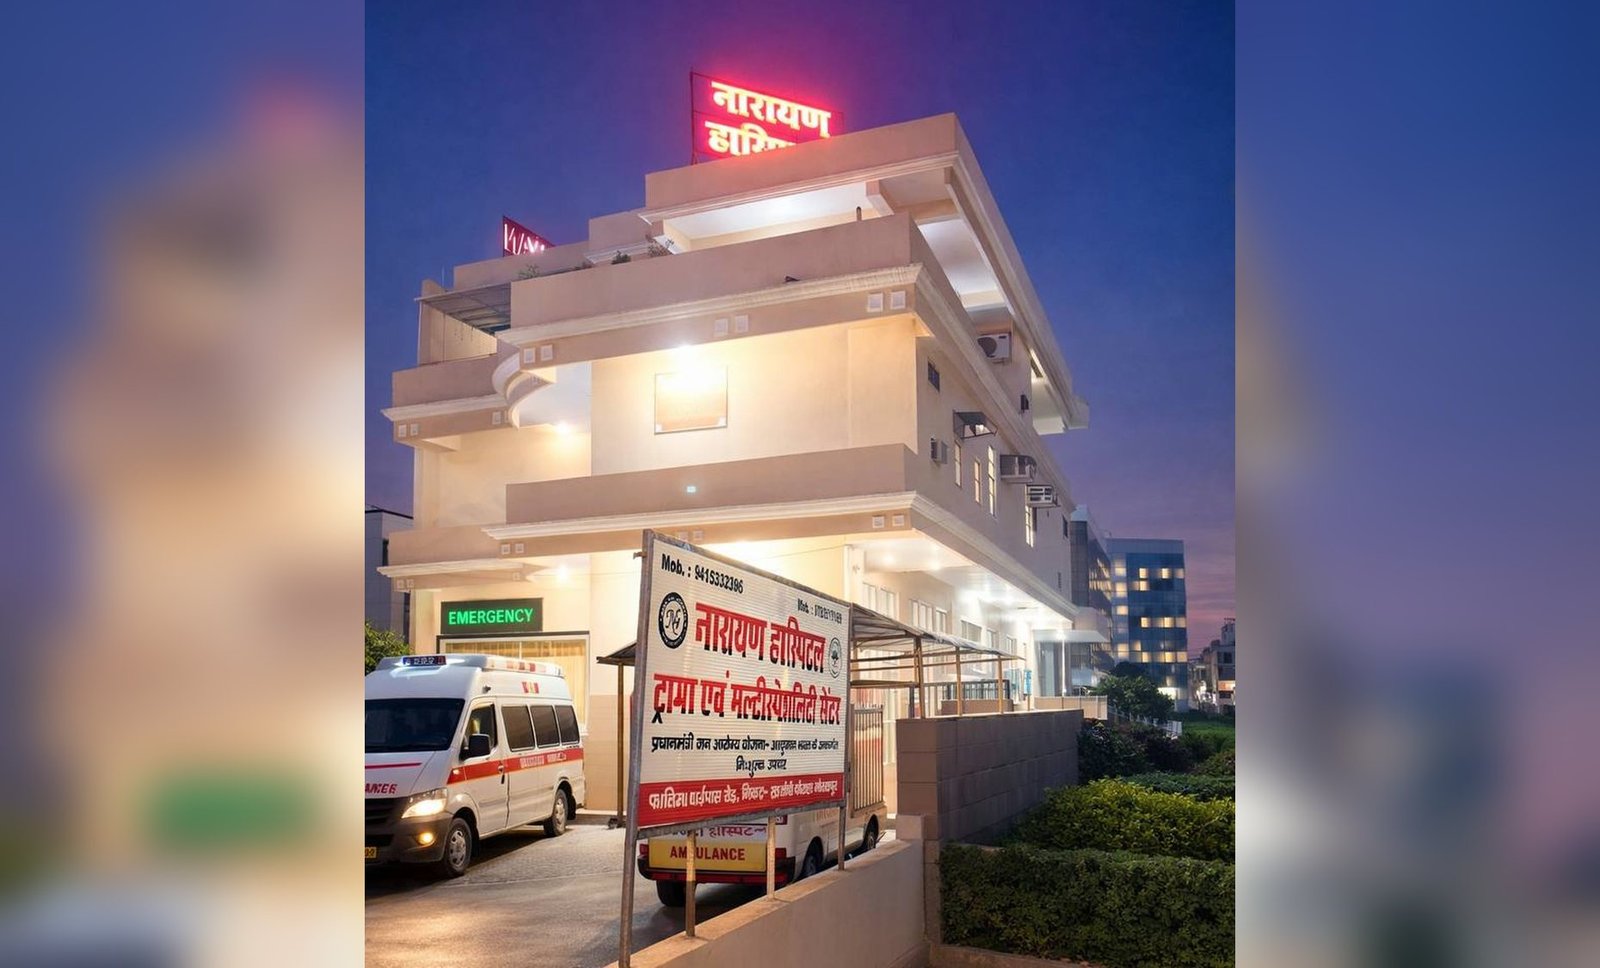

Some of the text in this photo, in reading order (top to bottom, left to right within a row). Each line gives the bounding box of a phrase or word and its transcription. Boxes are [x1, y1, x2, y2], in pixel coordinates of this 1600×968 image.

[711, 81, 831, 139] नारायण
[661, 553, 685, 577] Mob.
[448, 608, 534, 625] EMERGENCY
[695, 602, 767, 661] नारायण
[652, 674, 698, 723] ट्रामा
[700, 670, 728, 718] एवं
[670, 846, 745, 861] AMULANCE
